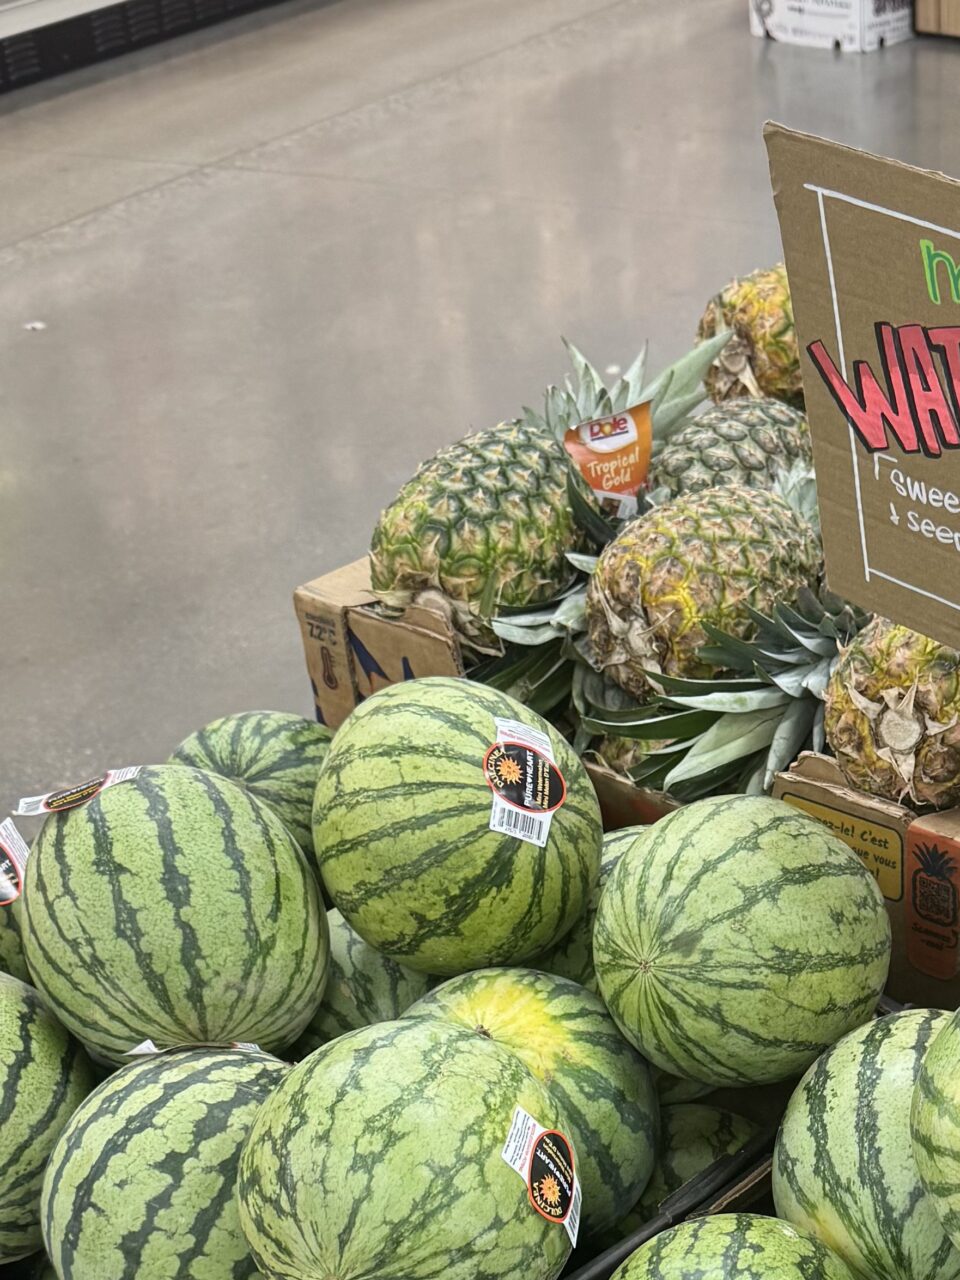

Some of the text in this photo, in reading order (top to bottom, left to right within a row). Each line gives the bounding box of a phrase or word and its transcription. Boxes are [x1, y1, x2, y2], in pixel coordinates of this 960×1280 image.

[587, 446, 640, 479] Tropical
[602, 468, 632, 491] Gold
[860, 830, 889, 850] C'est
[873, 853, 897, 870] vous
